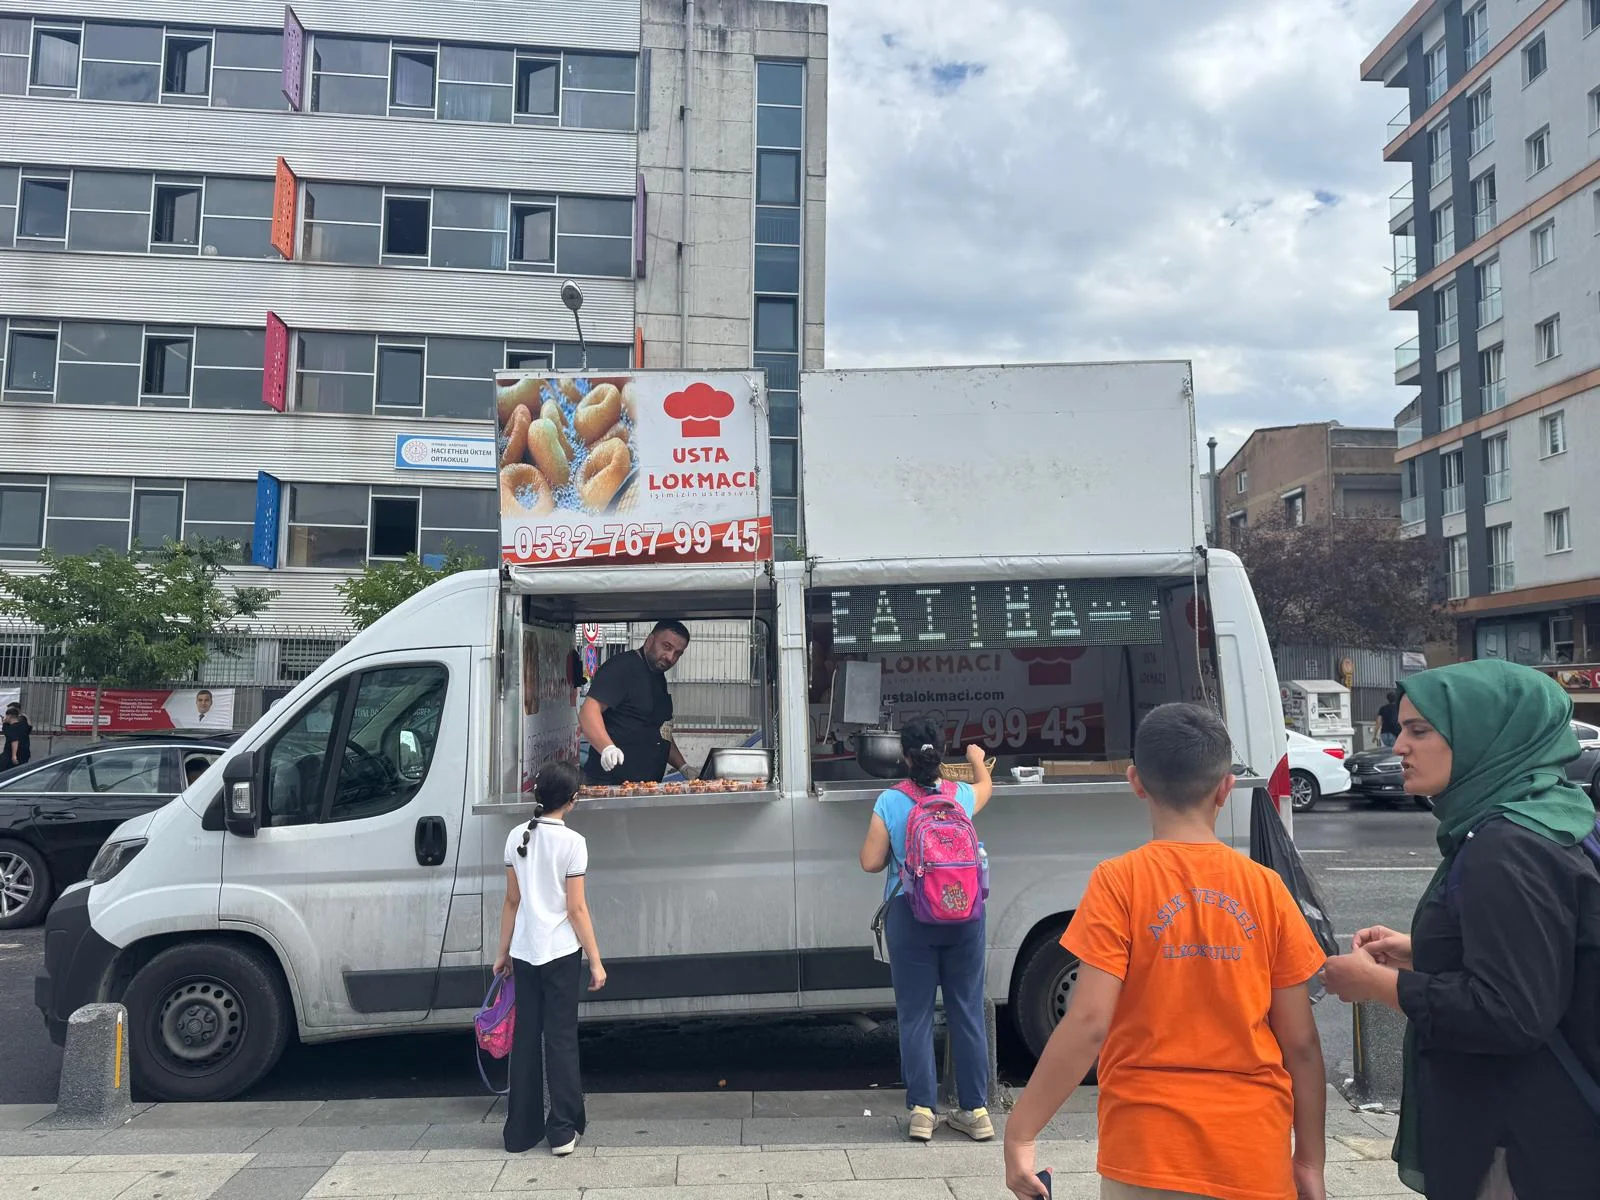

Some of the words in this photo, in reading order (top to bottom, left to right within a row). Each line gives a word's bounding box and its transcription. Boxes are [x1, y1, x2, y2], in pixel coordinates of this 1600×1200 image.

[469, 448, 492, 456] ÜKTEM
[672, 447, 730, 463] USTA
[648, 471, 755, 490] LOKMACI
[513, 524, 594, 559] 0532
[603, 522, 663, 556] 767
[672, 520, 712, 554] 99
[721, 519, 761, 552] 45
[881, 654, 1001, 674] LOKMACI
[982, 707, 1029, 749] 99
[1040, 706, 1088, 747] 45
[1190, 887, 1257, 939] VEYSEL
